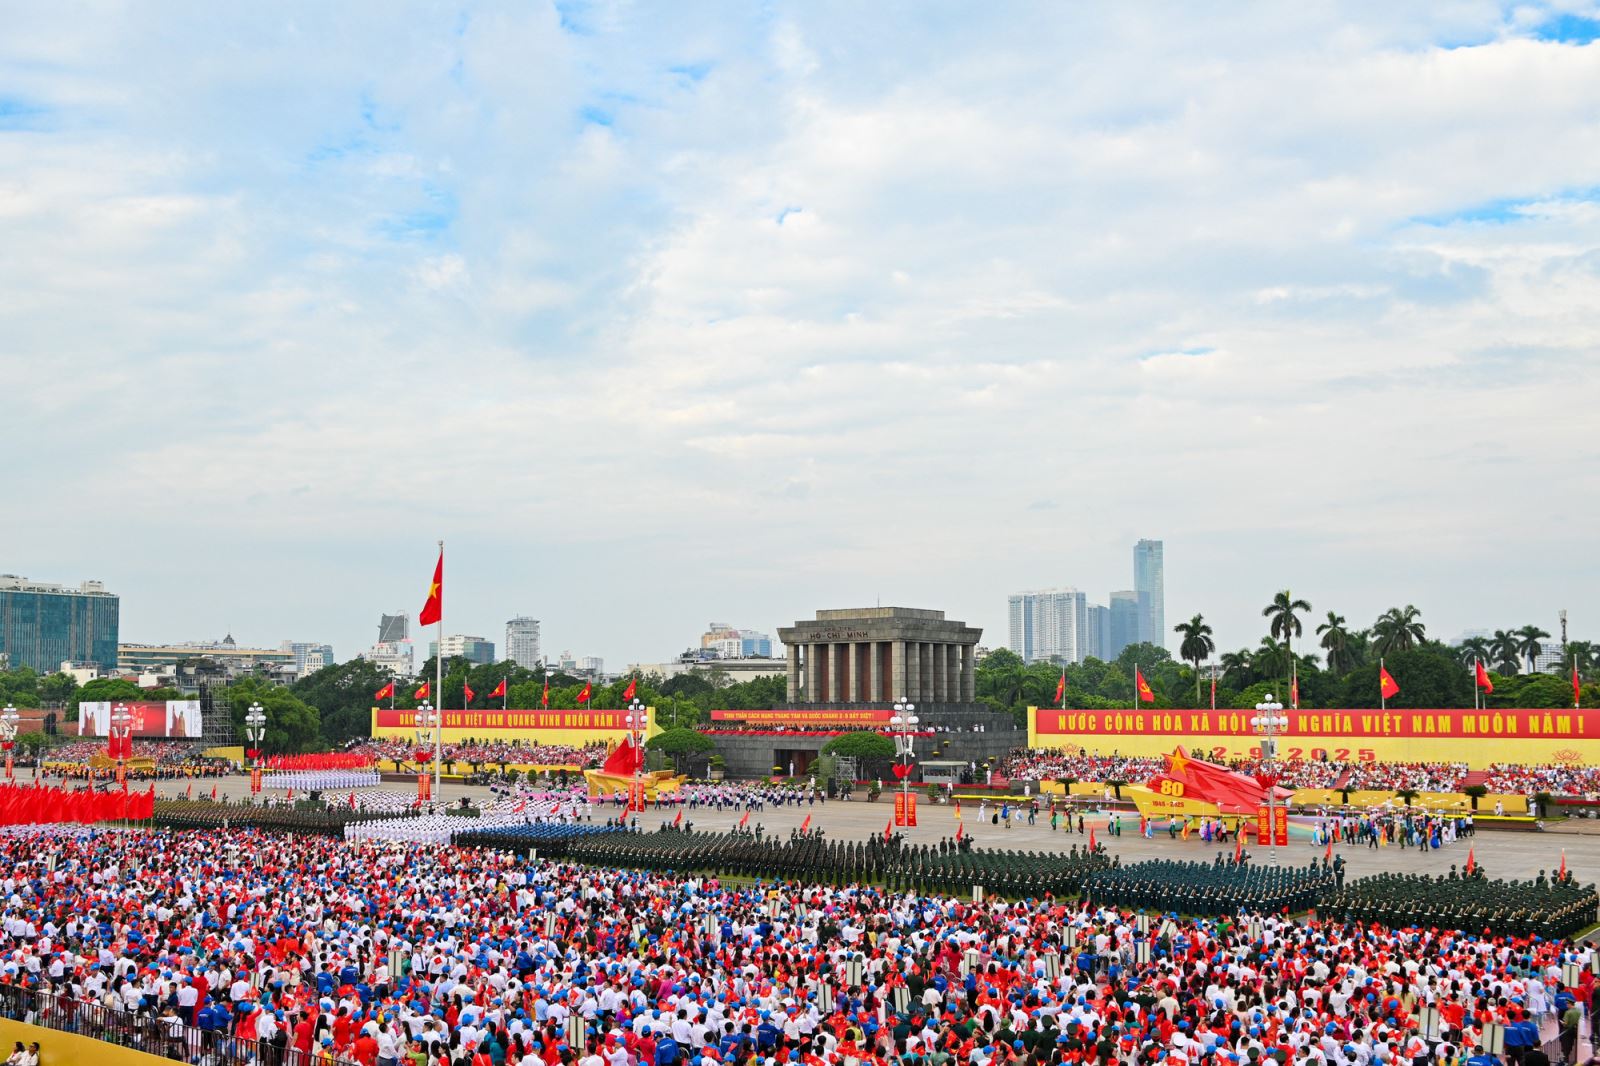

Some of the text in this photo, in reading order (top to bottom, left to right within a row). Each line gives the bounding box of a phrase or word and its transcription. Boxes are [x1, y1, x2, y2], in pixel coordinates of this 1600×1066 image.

[400, 711, 418, 726] ĐẢN
[464, 711, 483, 728] VIỆT
[486, 714, 504, 726] NAM
[507, 714, 535, 727] QUANG
[540, 714, 560, 726] VINH
[565, 712, 590, 727] MUÔN
[1058, 713, 1097, 731] NƯỚC
[1104, 712, 1144, 734] CỘNG
[1152, 713, 1183, 731] HÒA
[1191, 712, 1210, 731] XÃ
[1218, 712, 1247, 735] HỘI
[1298, 712, 1353, 733] NGHĨA
[1362, 712, 1402, 736] VIỆT
[1412, 715, 1451, 733] NAM
[1462, 712, 1518, 734] MUÔN
[1528, 712, 1571, 734] NĂM
[1160, 779, 1184, 797] 80
